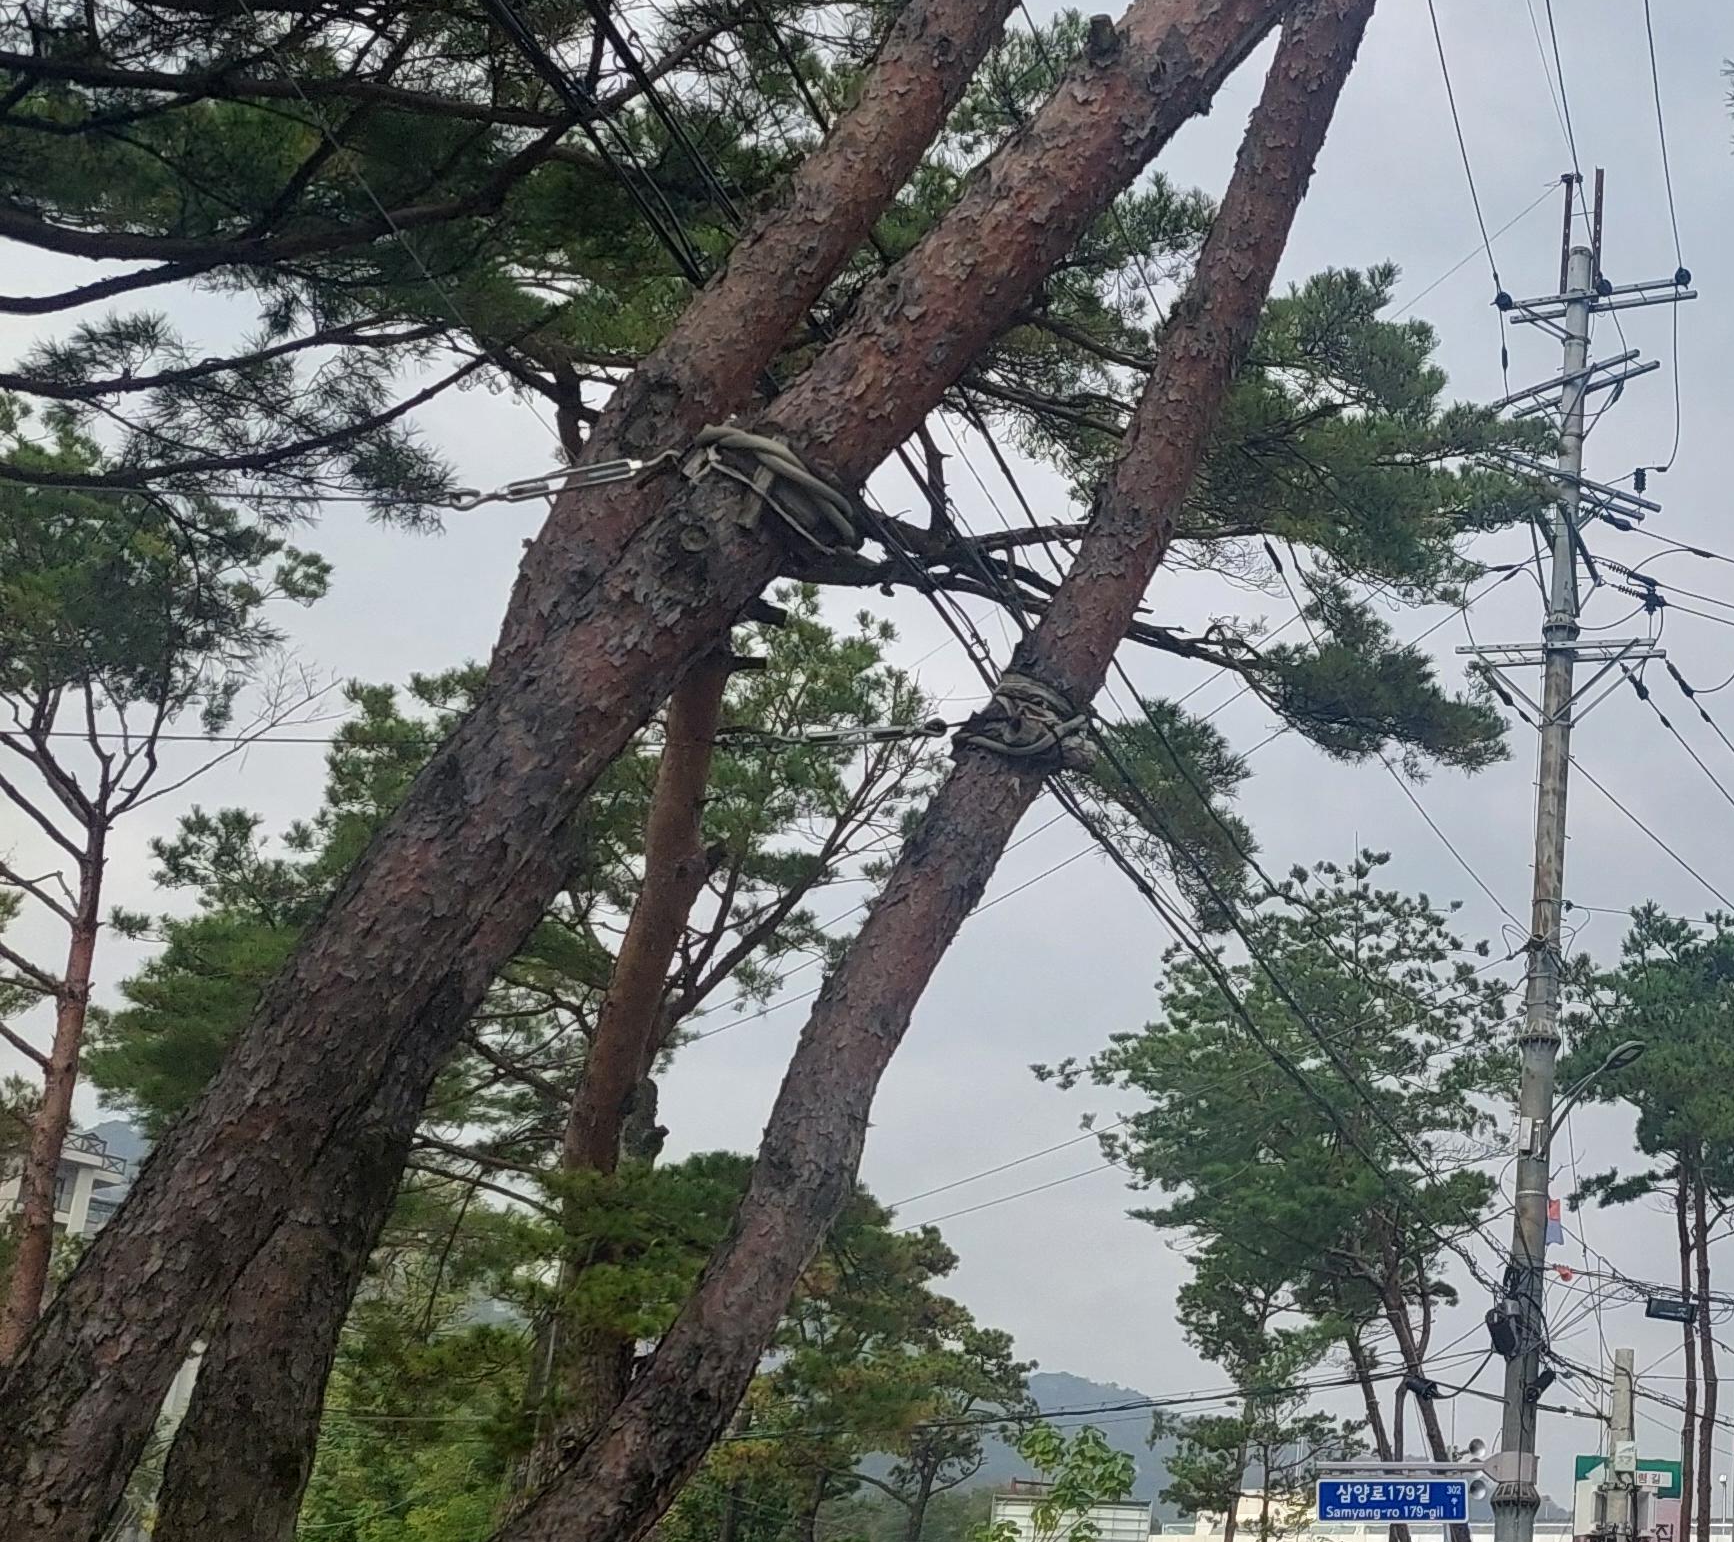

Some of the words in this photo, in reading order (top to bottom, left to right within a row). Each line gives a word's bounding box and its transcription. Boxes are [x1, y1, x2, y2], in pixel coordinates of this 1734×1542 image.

[1336, 1483, 1431, 1504] 삼양로179길
[1446, 1485, 1462, 1495] 302
[1326, 1506, 1400, 1520] Samyang-ro
[1403, 1506, 1444, 1520] 179-gil
